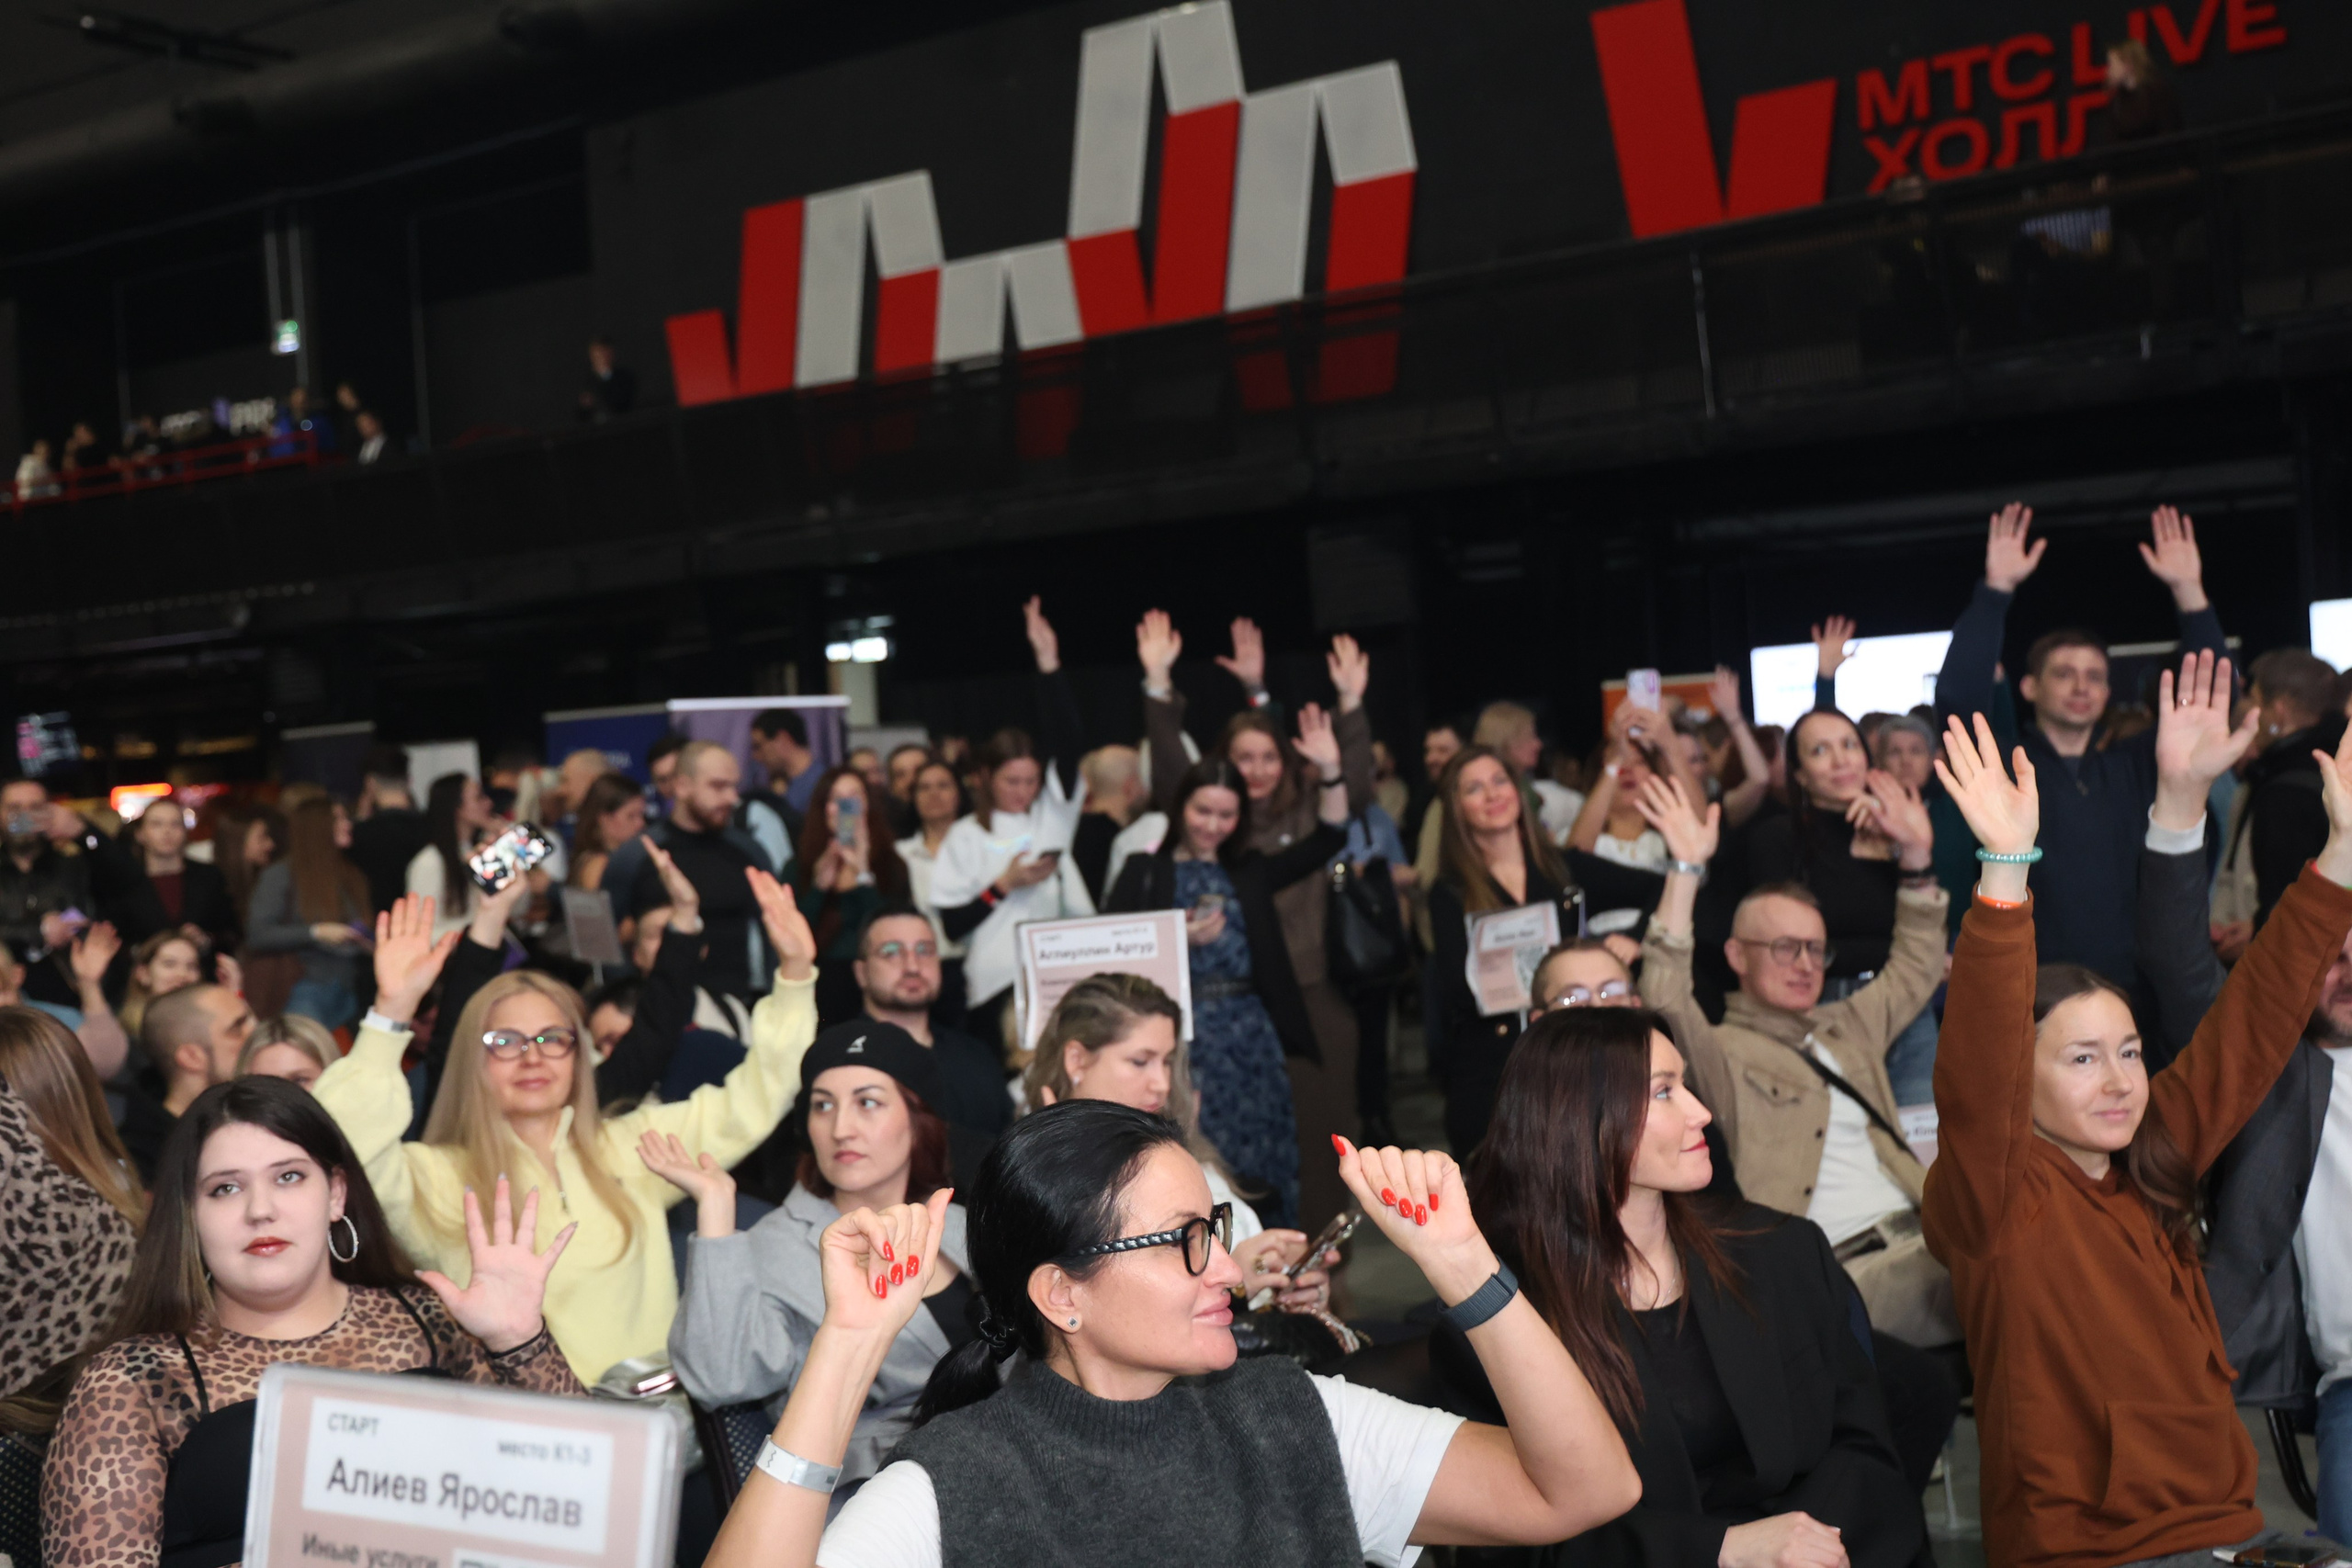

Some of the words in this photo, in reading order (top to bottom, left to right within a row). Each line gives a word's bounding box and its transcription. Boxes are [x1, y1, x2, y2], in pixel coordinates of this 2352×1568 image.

[1856, 33, 2054, 130] МТС
[2072, 0, 2288, 86] LIVE
[327, 1413, 379, 1436] СТАРТ
[497, 1440, 548, 1460] место
[326, 1458, 428, 1505] Алиев
[438, 1472, 583, 1528] Ярослав
[301, 1533, 360, 1564] Иные
